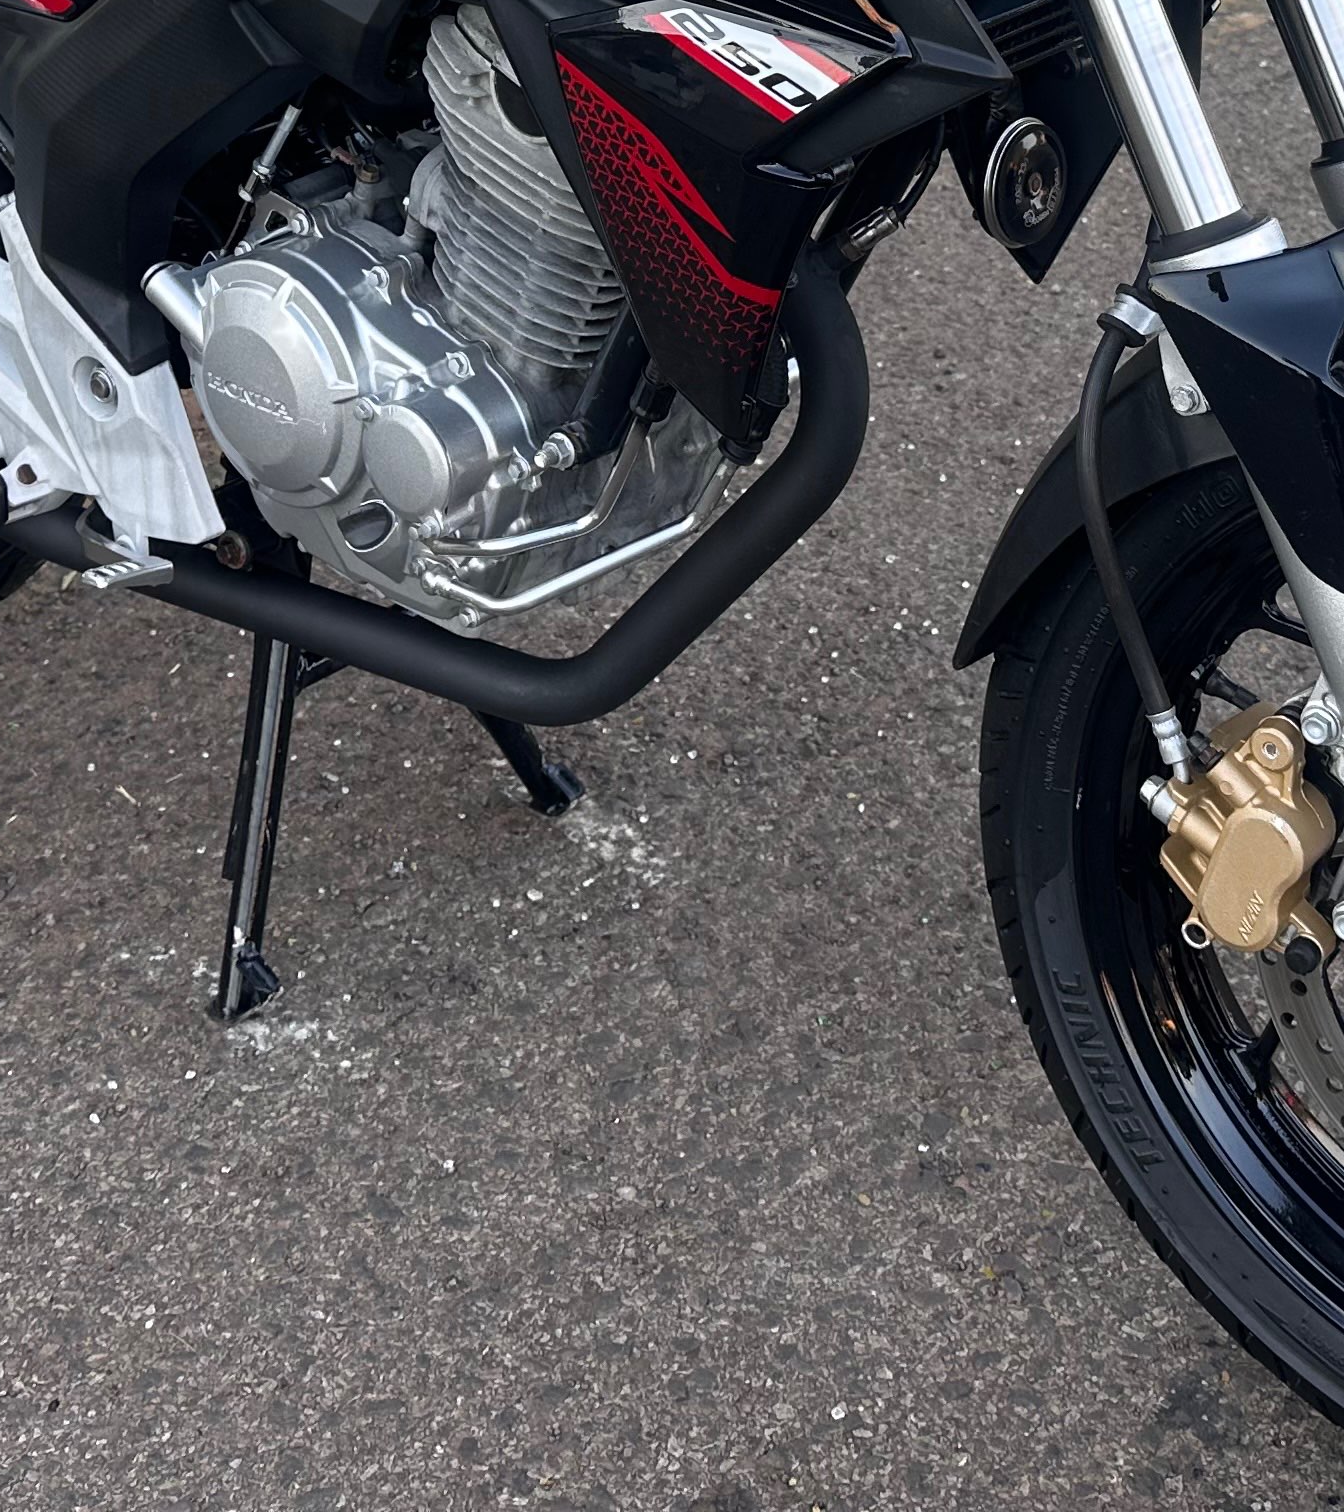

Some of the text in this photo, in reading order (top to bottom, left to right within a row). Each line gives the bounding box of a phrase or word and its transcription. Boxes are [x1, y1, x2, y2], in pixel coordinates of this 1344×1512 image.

[667, 10, 817, 108] 250
[207, 371, 294, 422] HONDA
[1053, 968, 1167, 1175] TECHNIC
